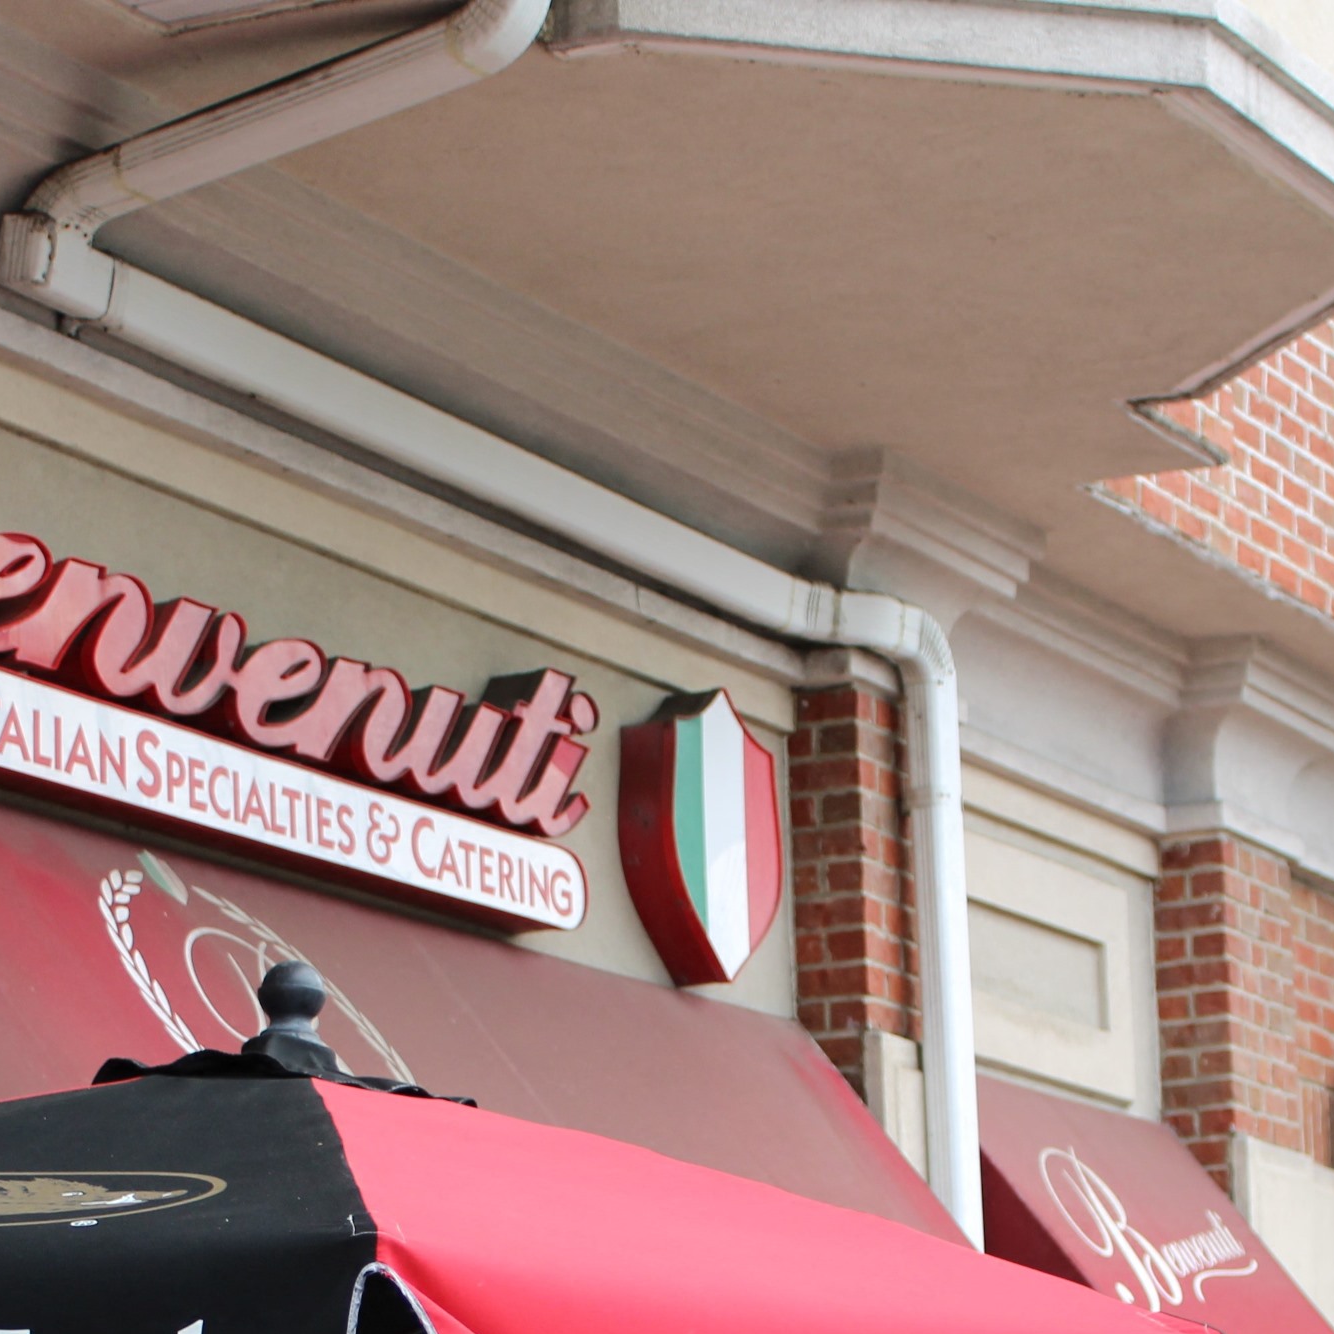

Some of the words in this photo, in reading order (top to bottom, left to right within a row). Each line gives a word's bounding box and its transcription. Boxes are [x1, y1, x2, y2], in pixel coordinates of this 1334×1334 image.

[136, 730, 356, 856] SPECIALTIES
[366, 800, 401, 866] &
[410, 817, 574, 918] CATERING
